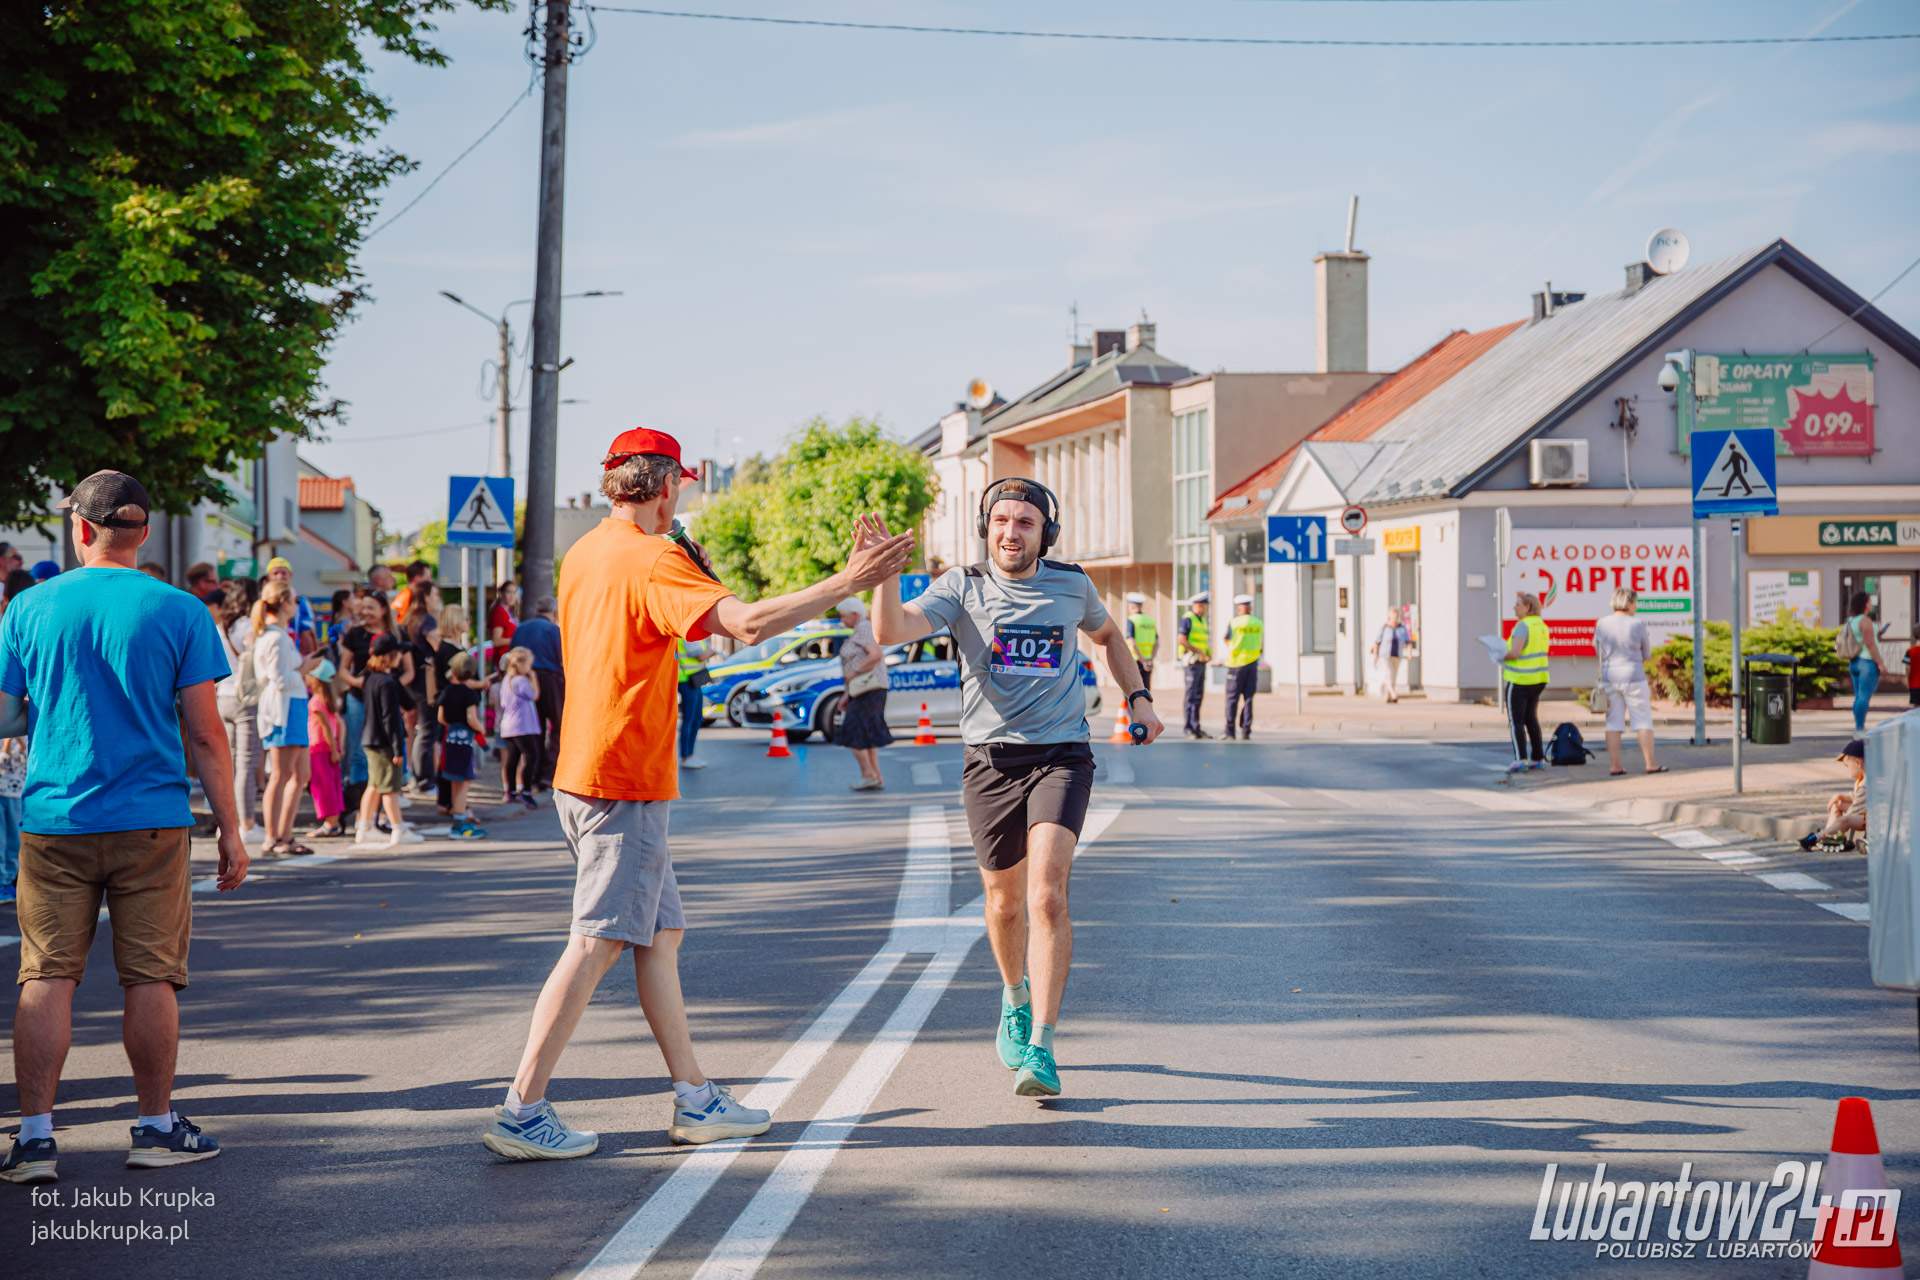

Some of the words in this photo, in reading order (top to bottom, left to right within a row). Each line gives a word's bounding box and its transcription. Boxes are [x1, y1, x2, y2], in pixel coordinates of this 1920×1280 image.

[1733, 364, 1792, 379] OPŁATY
[1843, 525, 1893, 541] KASA
[1516, 545, 1690, 561] CAŁODOBOWA
[1566, 566, 1690, 593] APTEKA
[1007, 638, 1051, 659] 102
